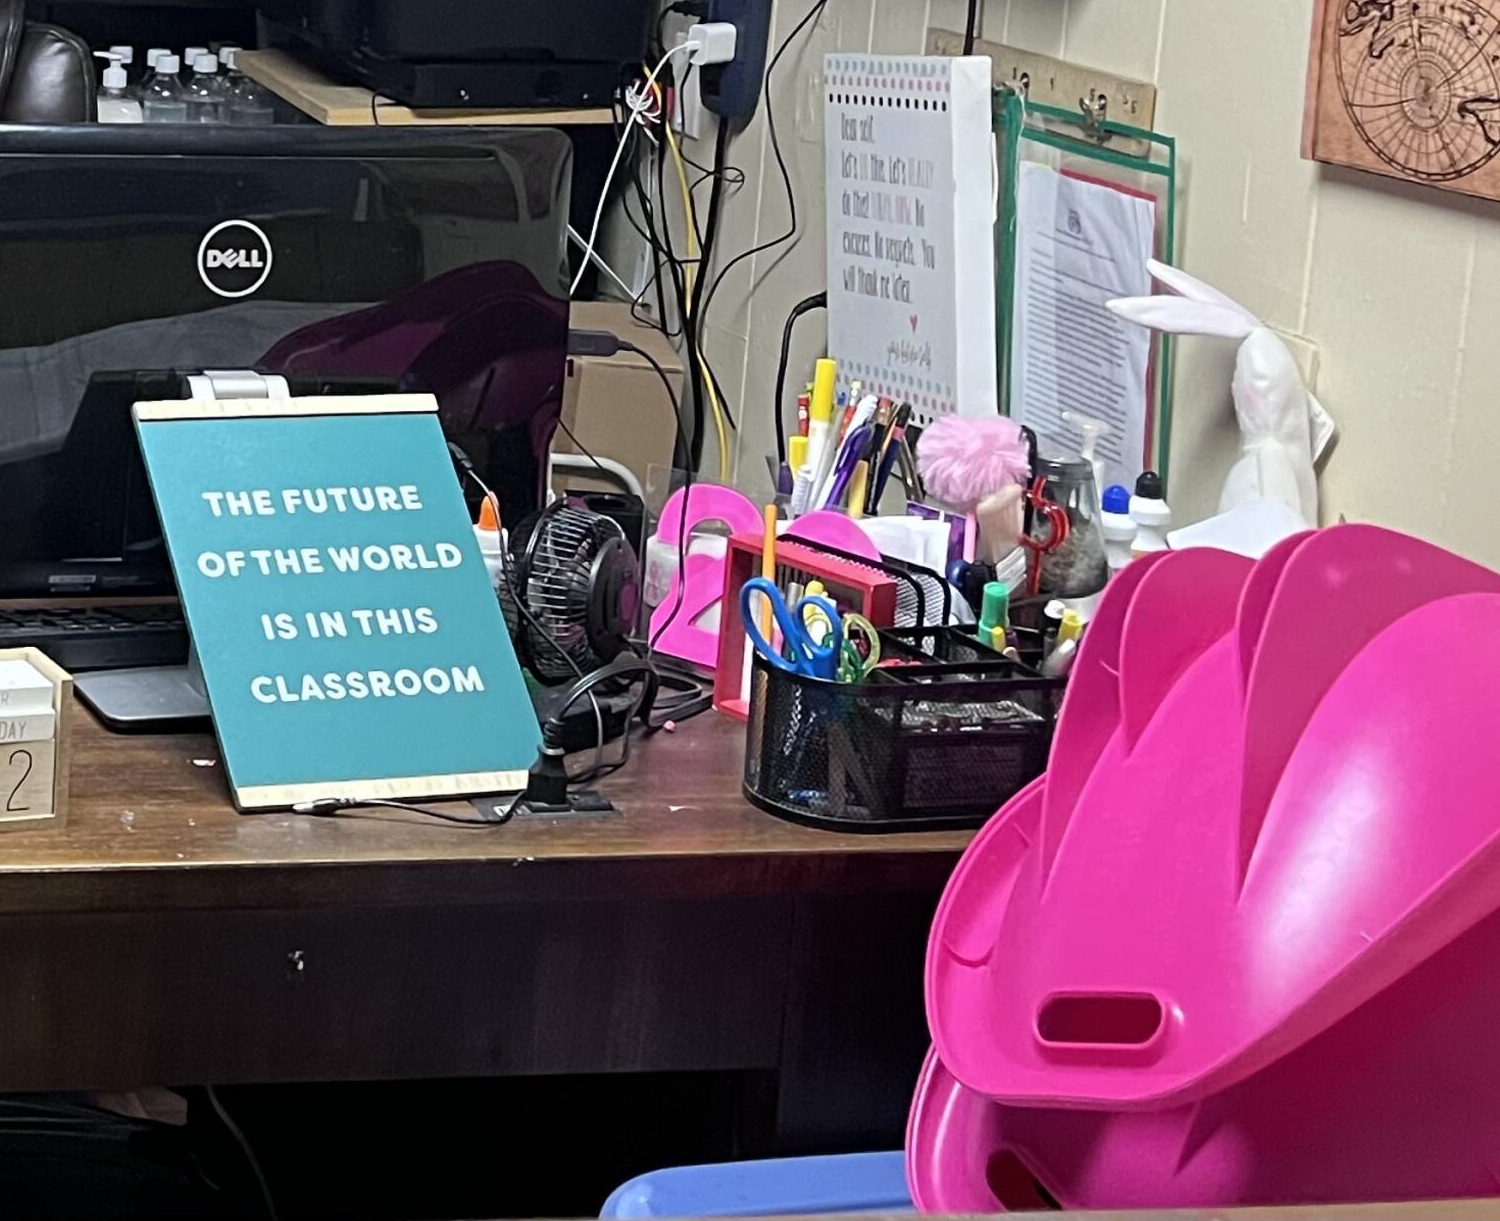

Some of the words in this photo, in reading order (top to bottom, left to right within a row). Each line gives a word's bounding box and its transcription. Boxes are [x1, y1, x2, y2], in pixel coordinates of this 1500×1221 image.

[206, 248, 263, 269] DELL
[202, 489, 275, 517] THE
[282, 485, 423, 514] FUTURE
[197, 550, 246, 578] OF
[250, 547, 325, 575] THE
[327, 542, 463, 572] WORLD
[261, 612, 298, 640] IS
[305, 611, 347, 638] IN
[351, 607, 438, 636] THIS
[251, 664, 485, 704] CLASSROOM
[6, 749, 33, 812] 2
